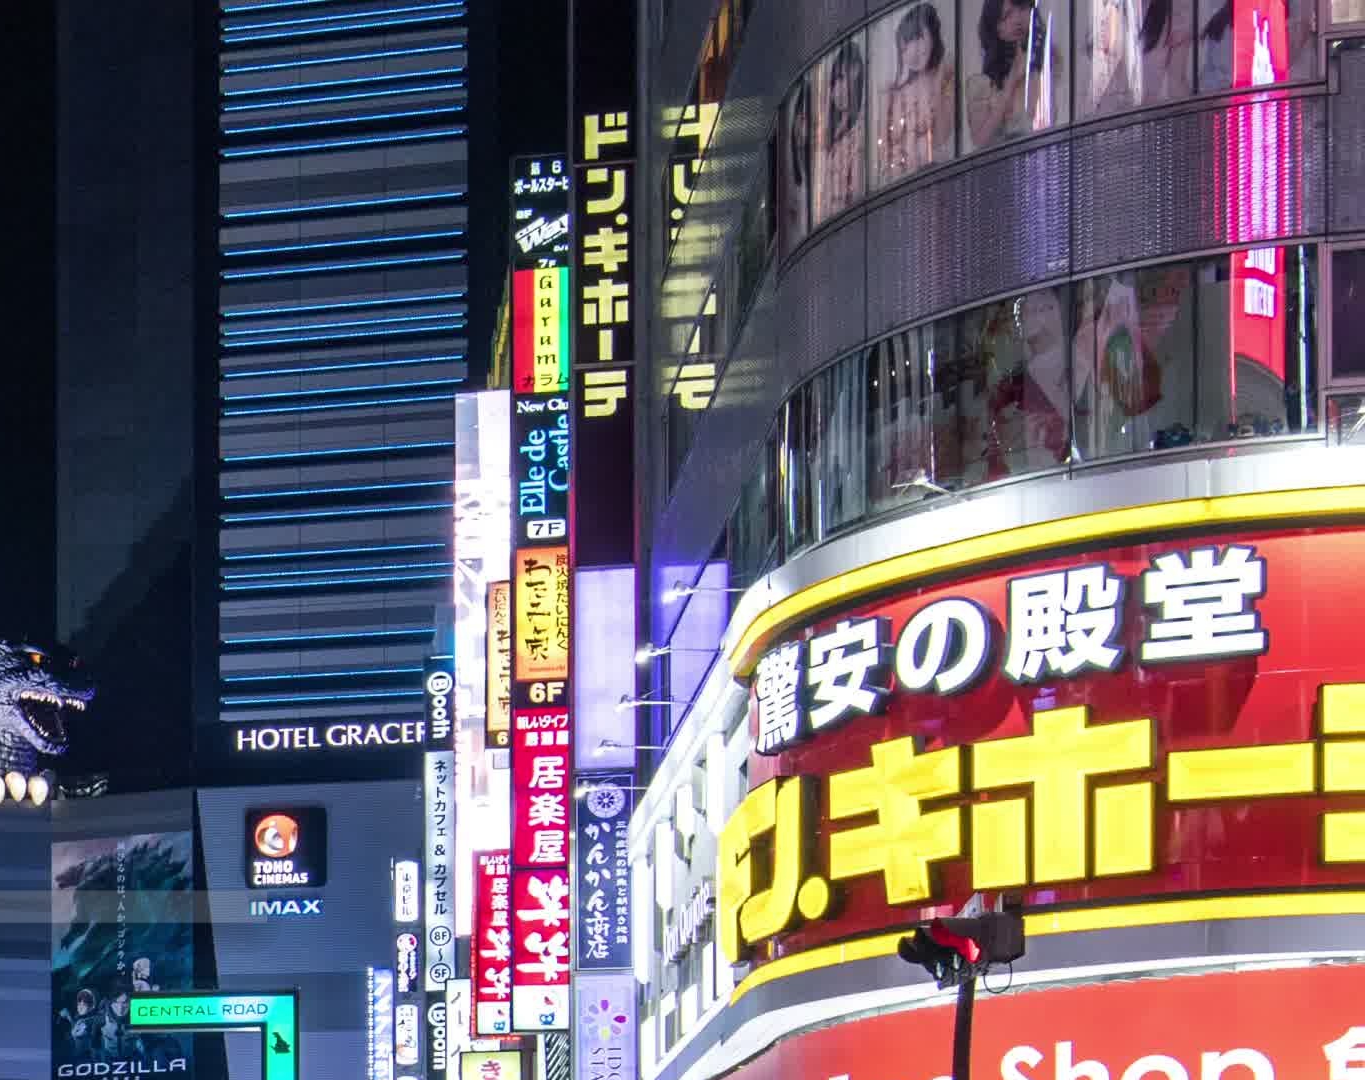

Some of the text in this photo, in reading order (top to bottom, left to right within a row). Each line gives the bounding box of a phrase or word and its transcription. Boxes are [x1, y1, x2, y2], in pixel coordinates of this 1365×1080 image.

[536, 276, 557, 365] Garum
[516, 400, 546, 413] New
[519, 428, 546, 516] Elle de
[531, 522, 561, 537] 7F
[754, 544, 1268, 756] 驚安の殿堂
[529, 682, 565, 704] 6F
[516, 715, 568, 730] 新しいタイプ
[236, 723, 321, 751] HOTEL
[528, 756, 567, 866] 居楽屋
[432, 758, 448, 917] ネットカフェ & カプセル
[252, 860, 294, 874] TOHO
[253, 871, 309, 885] CINEMAS
[584, 822, 611, 960] かんかん商店
[250, 899, 322, 917] IMAX
[491, 877, 509, 928] 居楽屋
[433, 931, 449, 942] 8F
[136, 1002, 269, 1018] CENTRAL ROAD
[57, 1058, 187, 1078] GODZILLA
